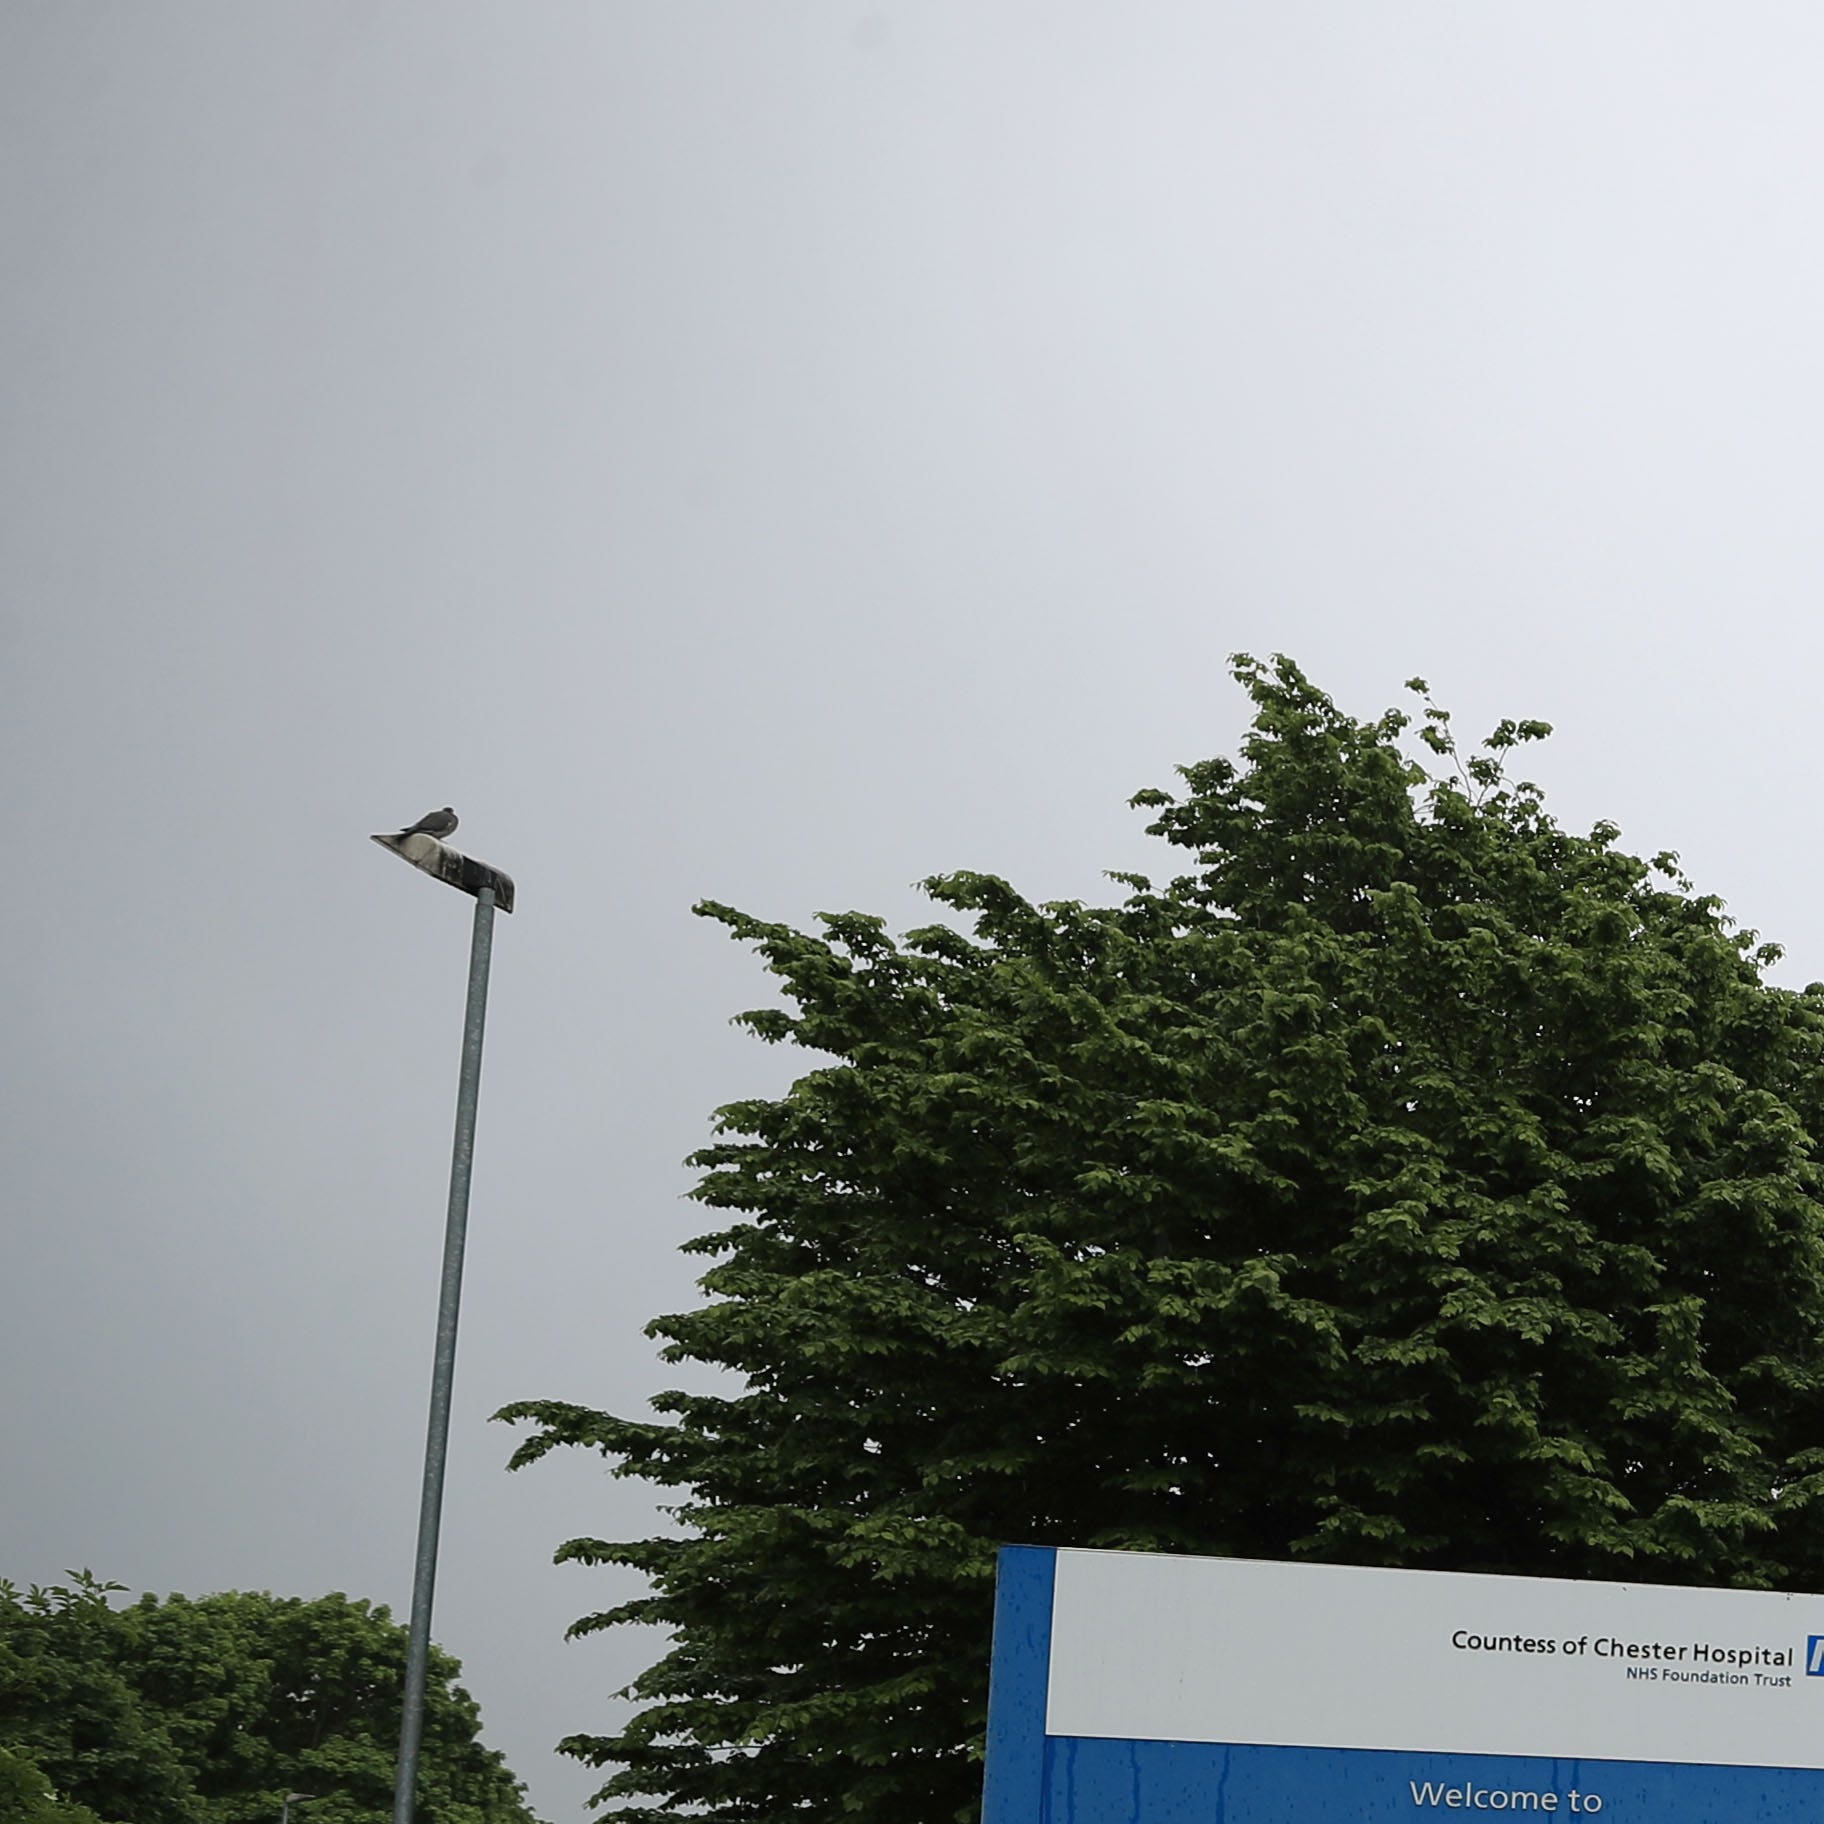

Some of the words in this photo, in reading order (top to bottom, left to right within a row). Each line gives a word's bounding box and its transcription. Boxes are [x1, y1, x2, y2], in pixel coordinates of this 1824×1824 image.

[1452, 1630, 1556, 1654] Countess
[1562, 1635, 1588, 1655] of
[1593, 1637, 1688, 1661] Chester
[1693, 1643, 1793, 1669] Hospital
[1626, 1666, 1658, 1681] NHS
[1662, 1668, 1749, 1686] Foundation
[1753, 1673, 1792, 1688] Trust
[1410, 1781, 1558, 1811] Welcome
[1567, 1789, 1602, 1813] to
